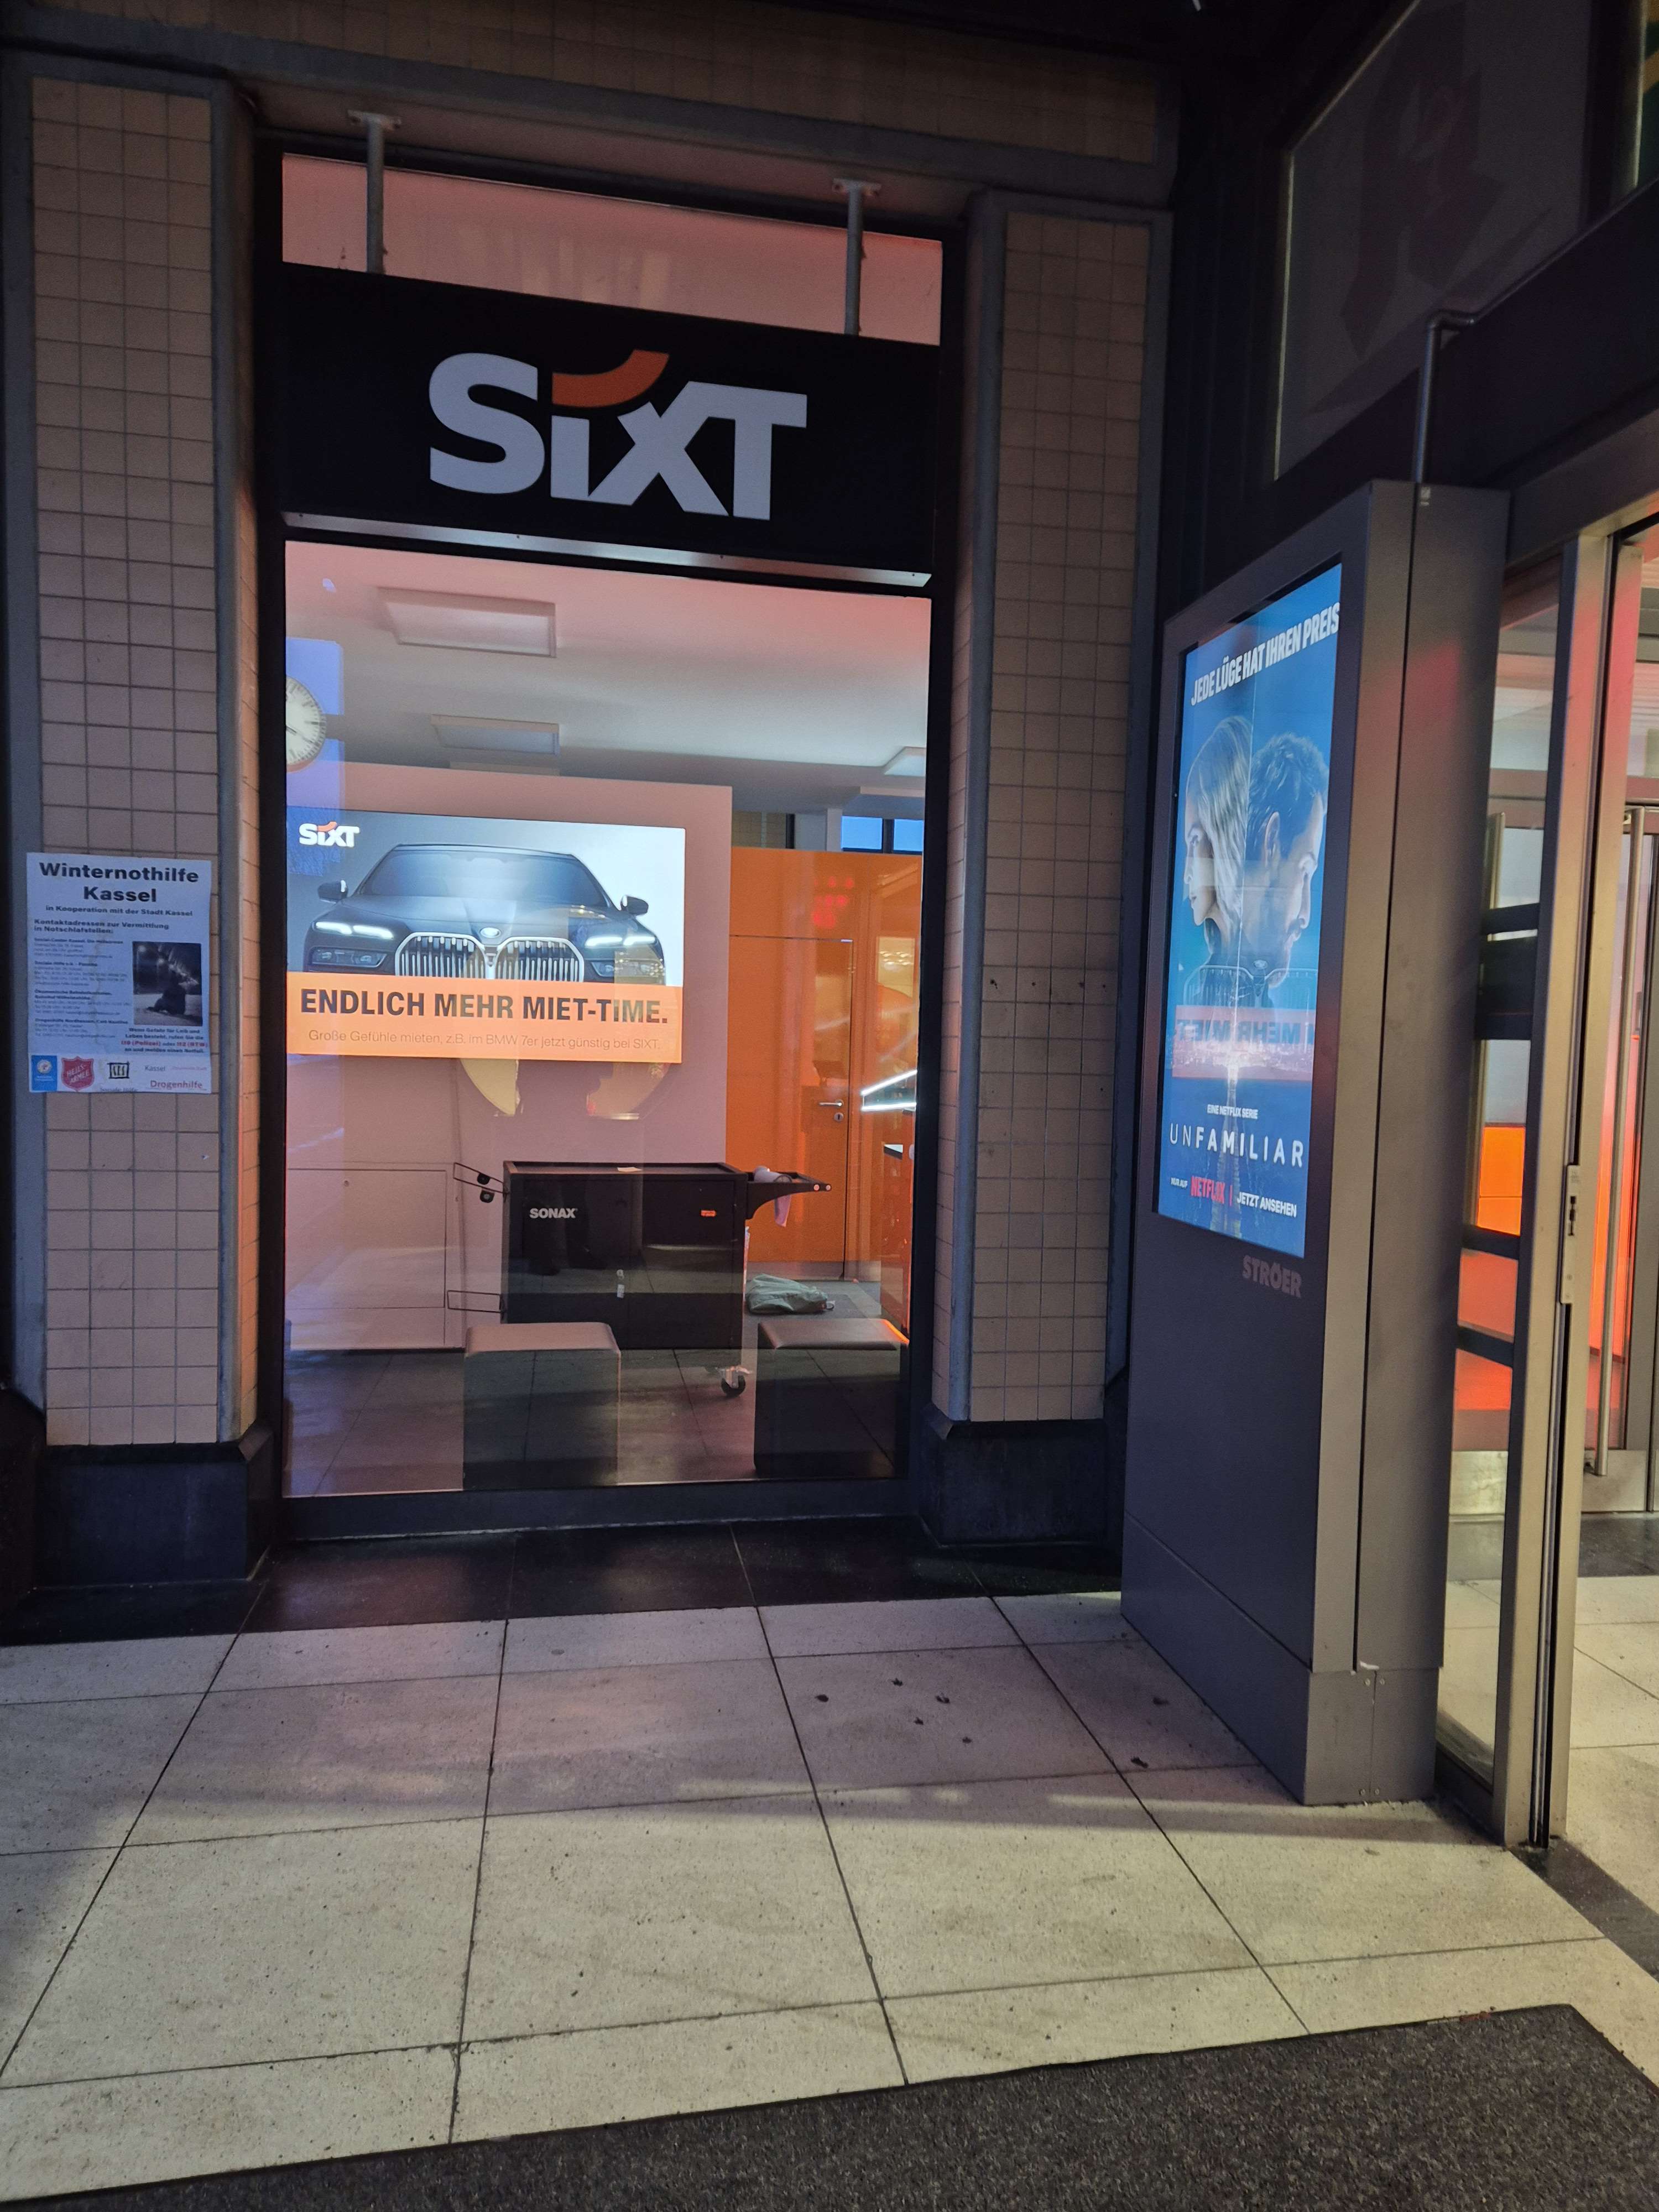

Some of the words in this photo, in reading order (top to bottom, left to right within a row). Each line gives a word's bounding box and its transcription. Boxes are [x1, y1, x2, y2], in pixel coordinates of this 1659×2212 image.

[429, 349, 807, 520] SIXT
[1191, 669, 1215, 706] JEDE
[1215, 655, 1243, 693] LÜGE
[1243, 643, 1266, 680] HAT
[1266, 622, 1301, 668] IHREN
[1302, 602, 1340, 649] PREIS
[39, 862, 199, 883] Winternothilfe
[84, 886, 156, 902] Kassel
[122, 922, 169, 930] Vermittlung
[301, 988, 425, 1016] ENDLICH
[435, 993, 513, 1019] MEHR
[523, 996, 667, 1024] MIET-TIME.
[309, 1029, 346, 1041] Große
[350, 1030, 397, 1042] Gefühle
[400, 1032, 443, 1044] mieten,
[446, 1033, 466, 1044] z.B.
[469, 1034, 483, 1044] im
[486, 1034, 518, 1045] BMW
[521, 1035, 538, 1047] 7er
[541, 1037, 565, 1049] jetzt
[568, 1037, 609, 1050] günstig
[613, 1039, 630, 1048] bei
[150, 1080, 202, 1090] Drogenhilfe
[1207, 1104, 1219, 1115] EINE
[1219, 1105, 1241, 1118] NETFLIX
[1241, 1108, 1258, 1119] SERIE
[1169, 1123, 1304, 1168] UNFAMILIAR
[1191, 1175, 1225, 1204] NETFLIX
[1237, 1191, 1259, 1208] JETZT
[1260, 1196, 1297, 1218] ANSEHEN
[530, 1208, 576, 1218] SONAX
